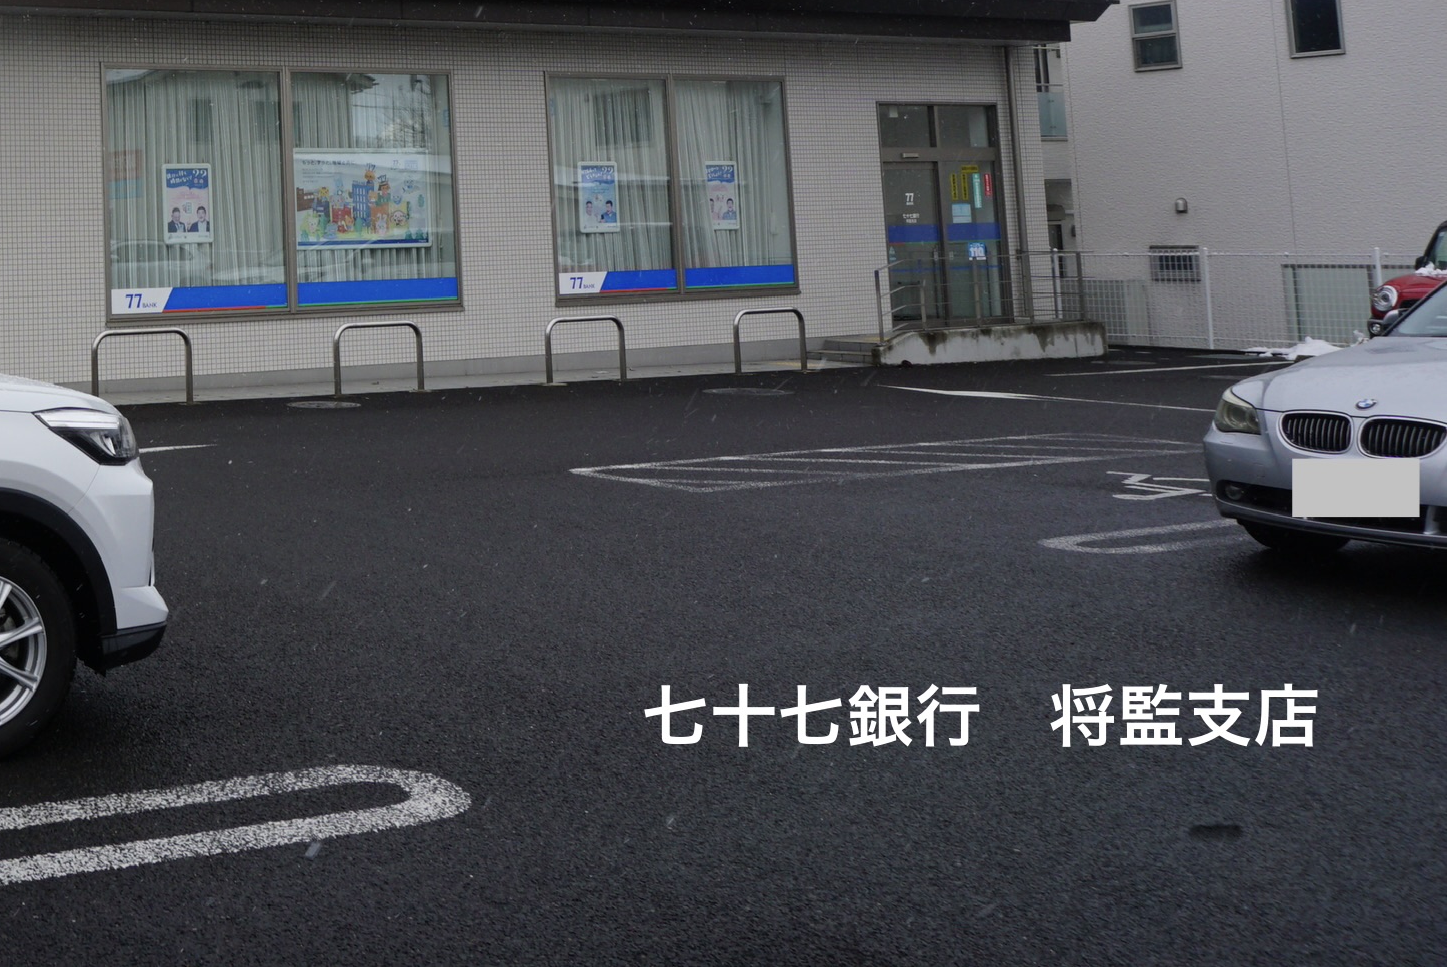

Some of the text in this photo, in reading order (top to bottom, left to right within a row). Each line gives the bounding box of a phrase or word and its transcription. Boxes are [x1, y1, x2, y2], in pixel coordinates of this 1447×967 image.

[905, 192, 914, 202] 77
[570, 277, 583, 289] 77
[125, 293, 142, 308] 77
